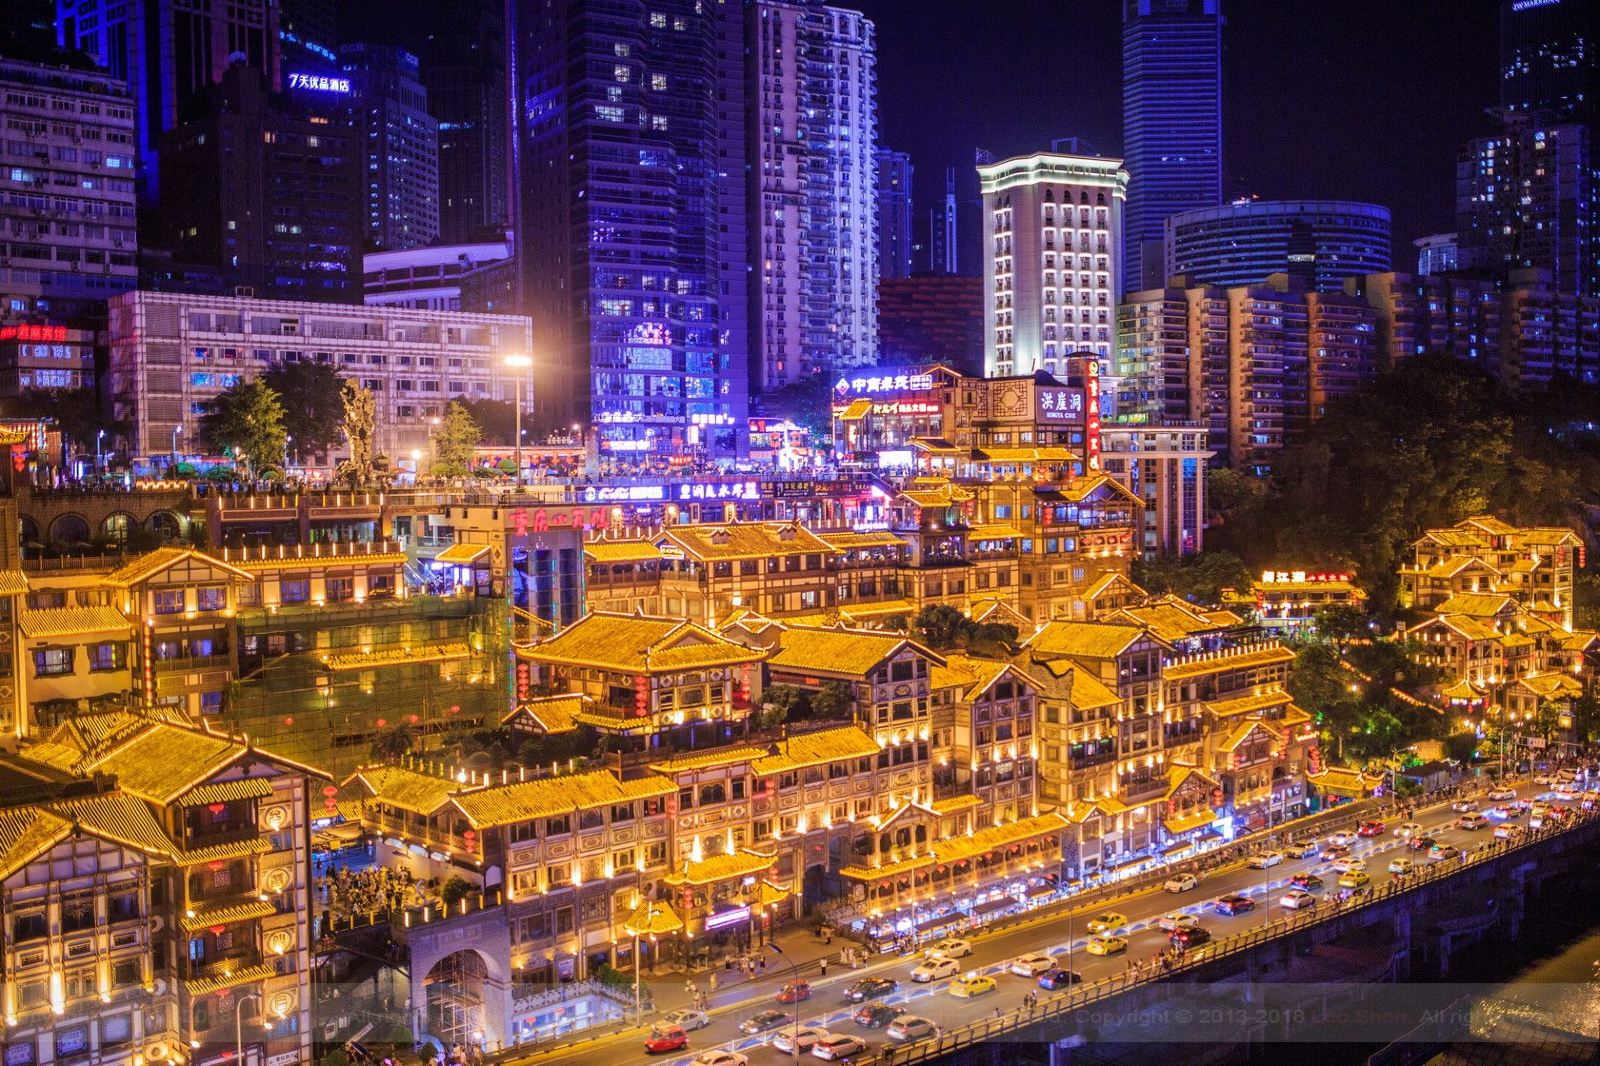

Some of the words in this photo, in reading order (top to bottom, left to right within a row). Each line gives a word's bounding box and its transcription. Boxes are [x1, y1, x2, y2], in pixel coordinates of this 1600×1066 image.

[289, 73, 350, 93] 7天优品酒店
[1041, 392, 1081, 411] 洪崖洞
